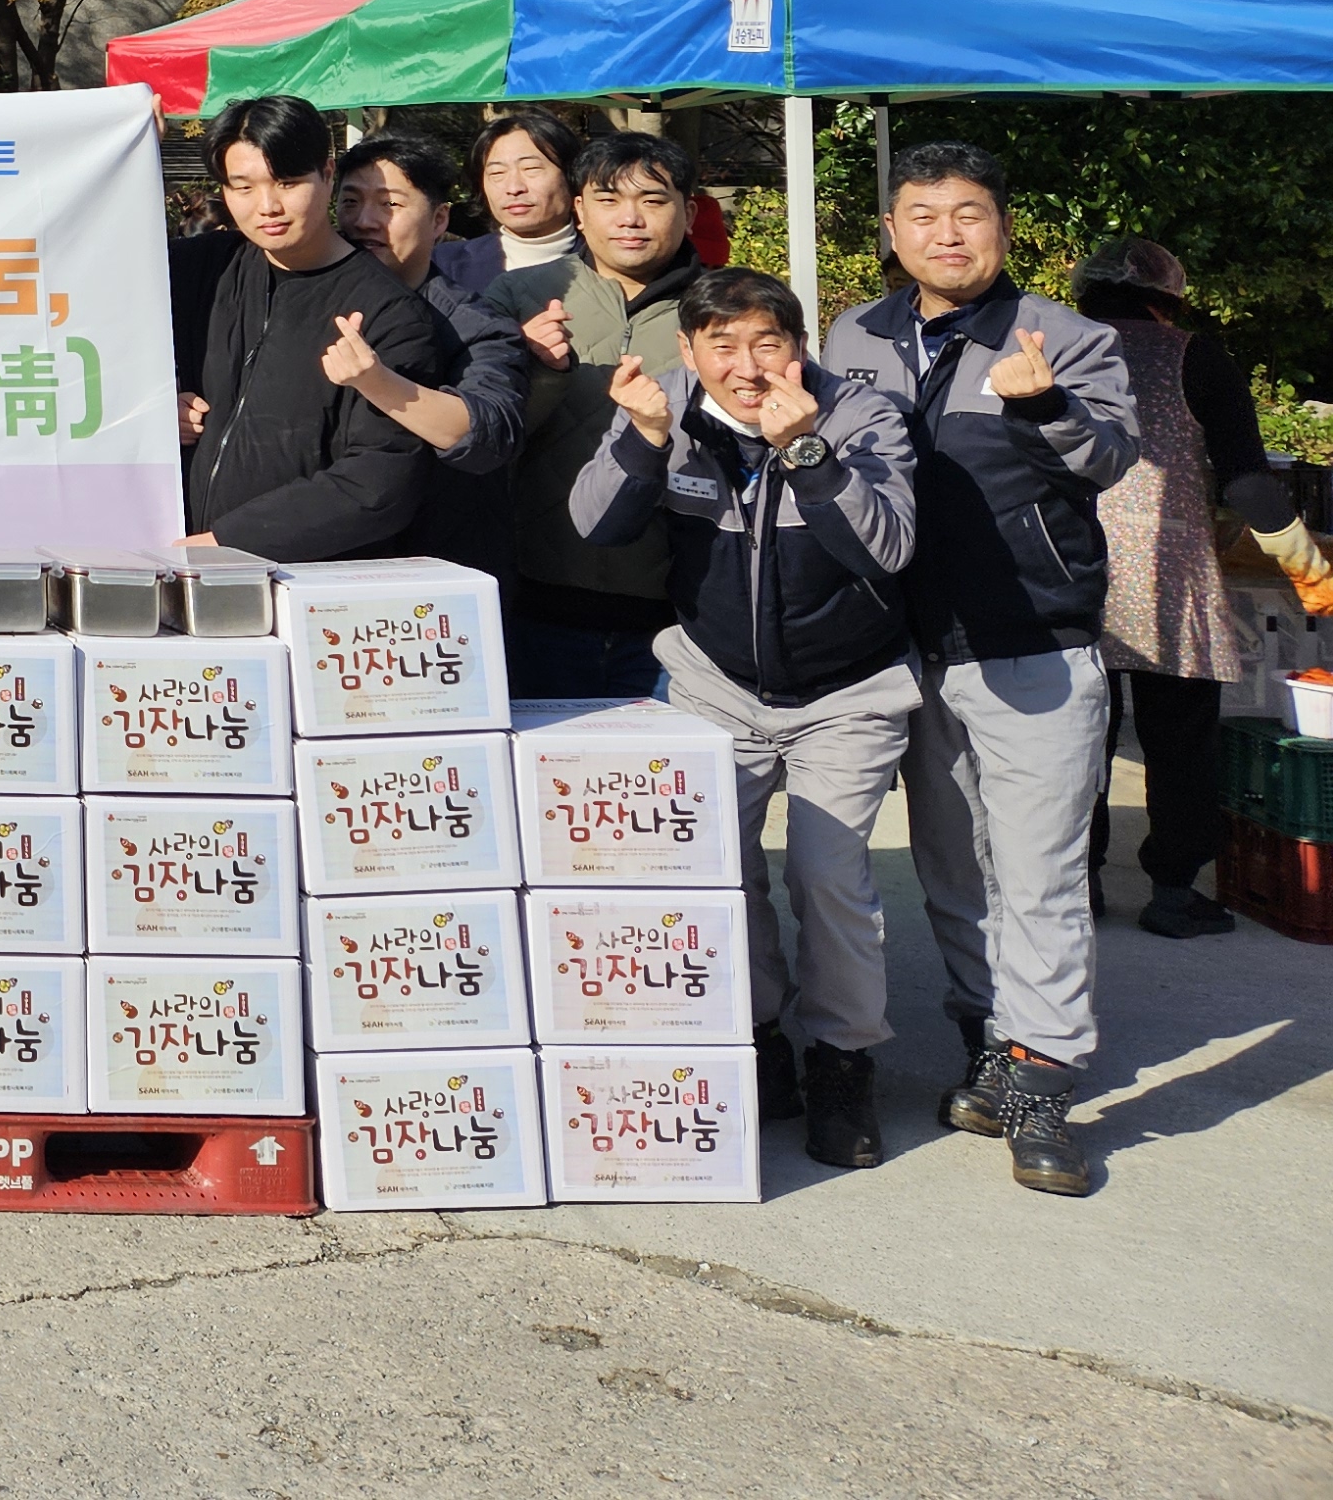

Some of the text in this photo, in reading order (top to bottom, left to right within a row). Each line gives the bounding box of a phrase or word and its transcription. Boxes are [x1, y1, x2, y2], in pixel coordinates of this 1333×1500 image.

[352, 615, 422, 645] 사랑의
[327, 642, 463, 690] 김장나눔
[138, 677, 210, 706] 사랑의
[113, 705, 249, 749] 김장나눔
[360, 768, 431, 798] 사랑의
[583, 770, 657, 799] 사랑의
[335, 795, 472, 844] 김장나눔
[556, 798, 698, 842] 김장나눔
[148, 831, 220, 860] 사랑의
[123, 860, 258, 904] 김장나눔
[369, 924, 441, 954] 사랑의
[596, 924, 670, 953] 사랑의
[344, 952, 483, 999] 김장나눔
[569, 953, 710, 997] 김장나눔
[149, 992, 221, 1021] 사랑의
[123, 1020, 260, 1065] 김장나눔
[384, 1087, 456, 1118] 사랑의
[606, 1078, 680, 1108] 사랑의
[359, 1115, 498, 1164] 김장나눔
[580, 1108, 720, 1153] 김장나눔
